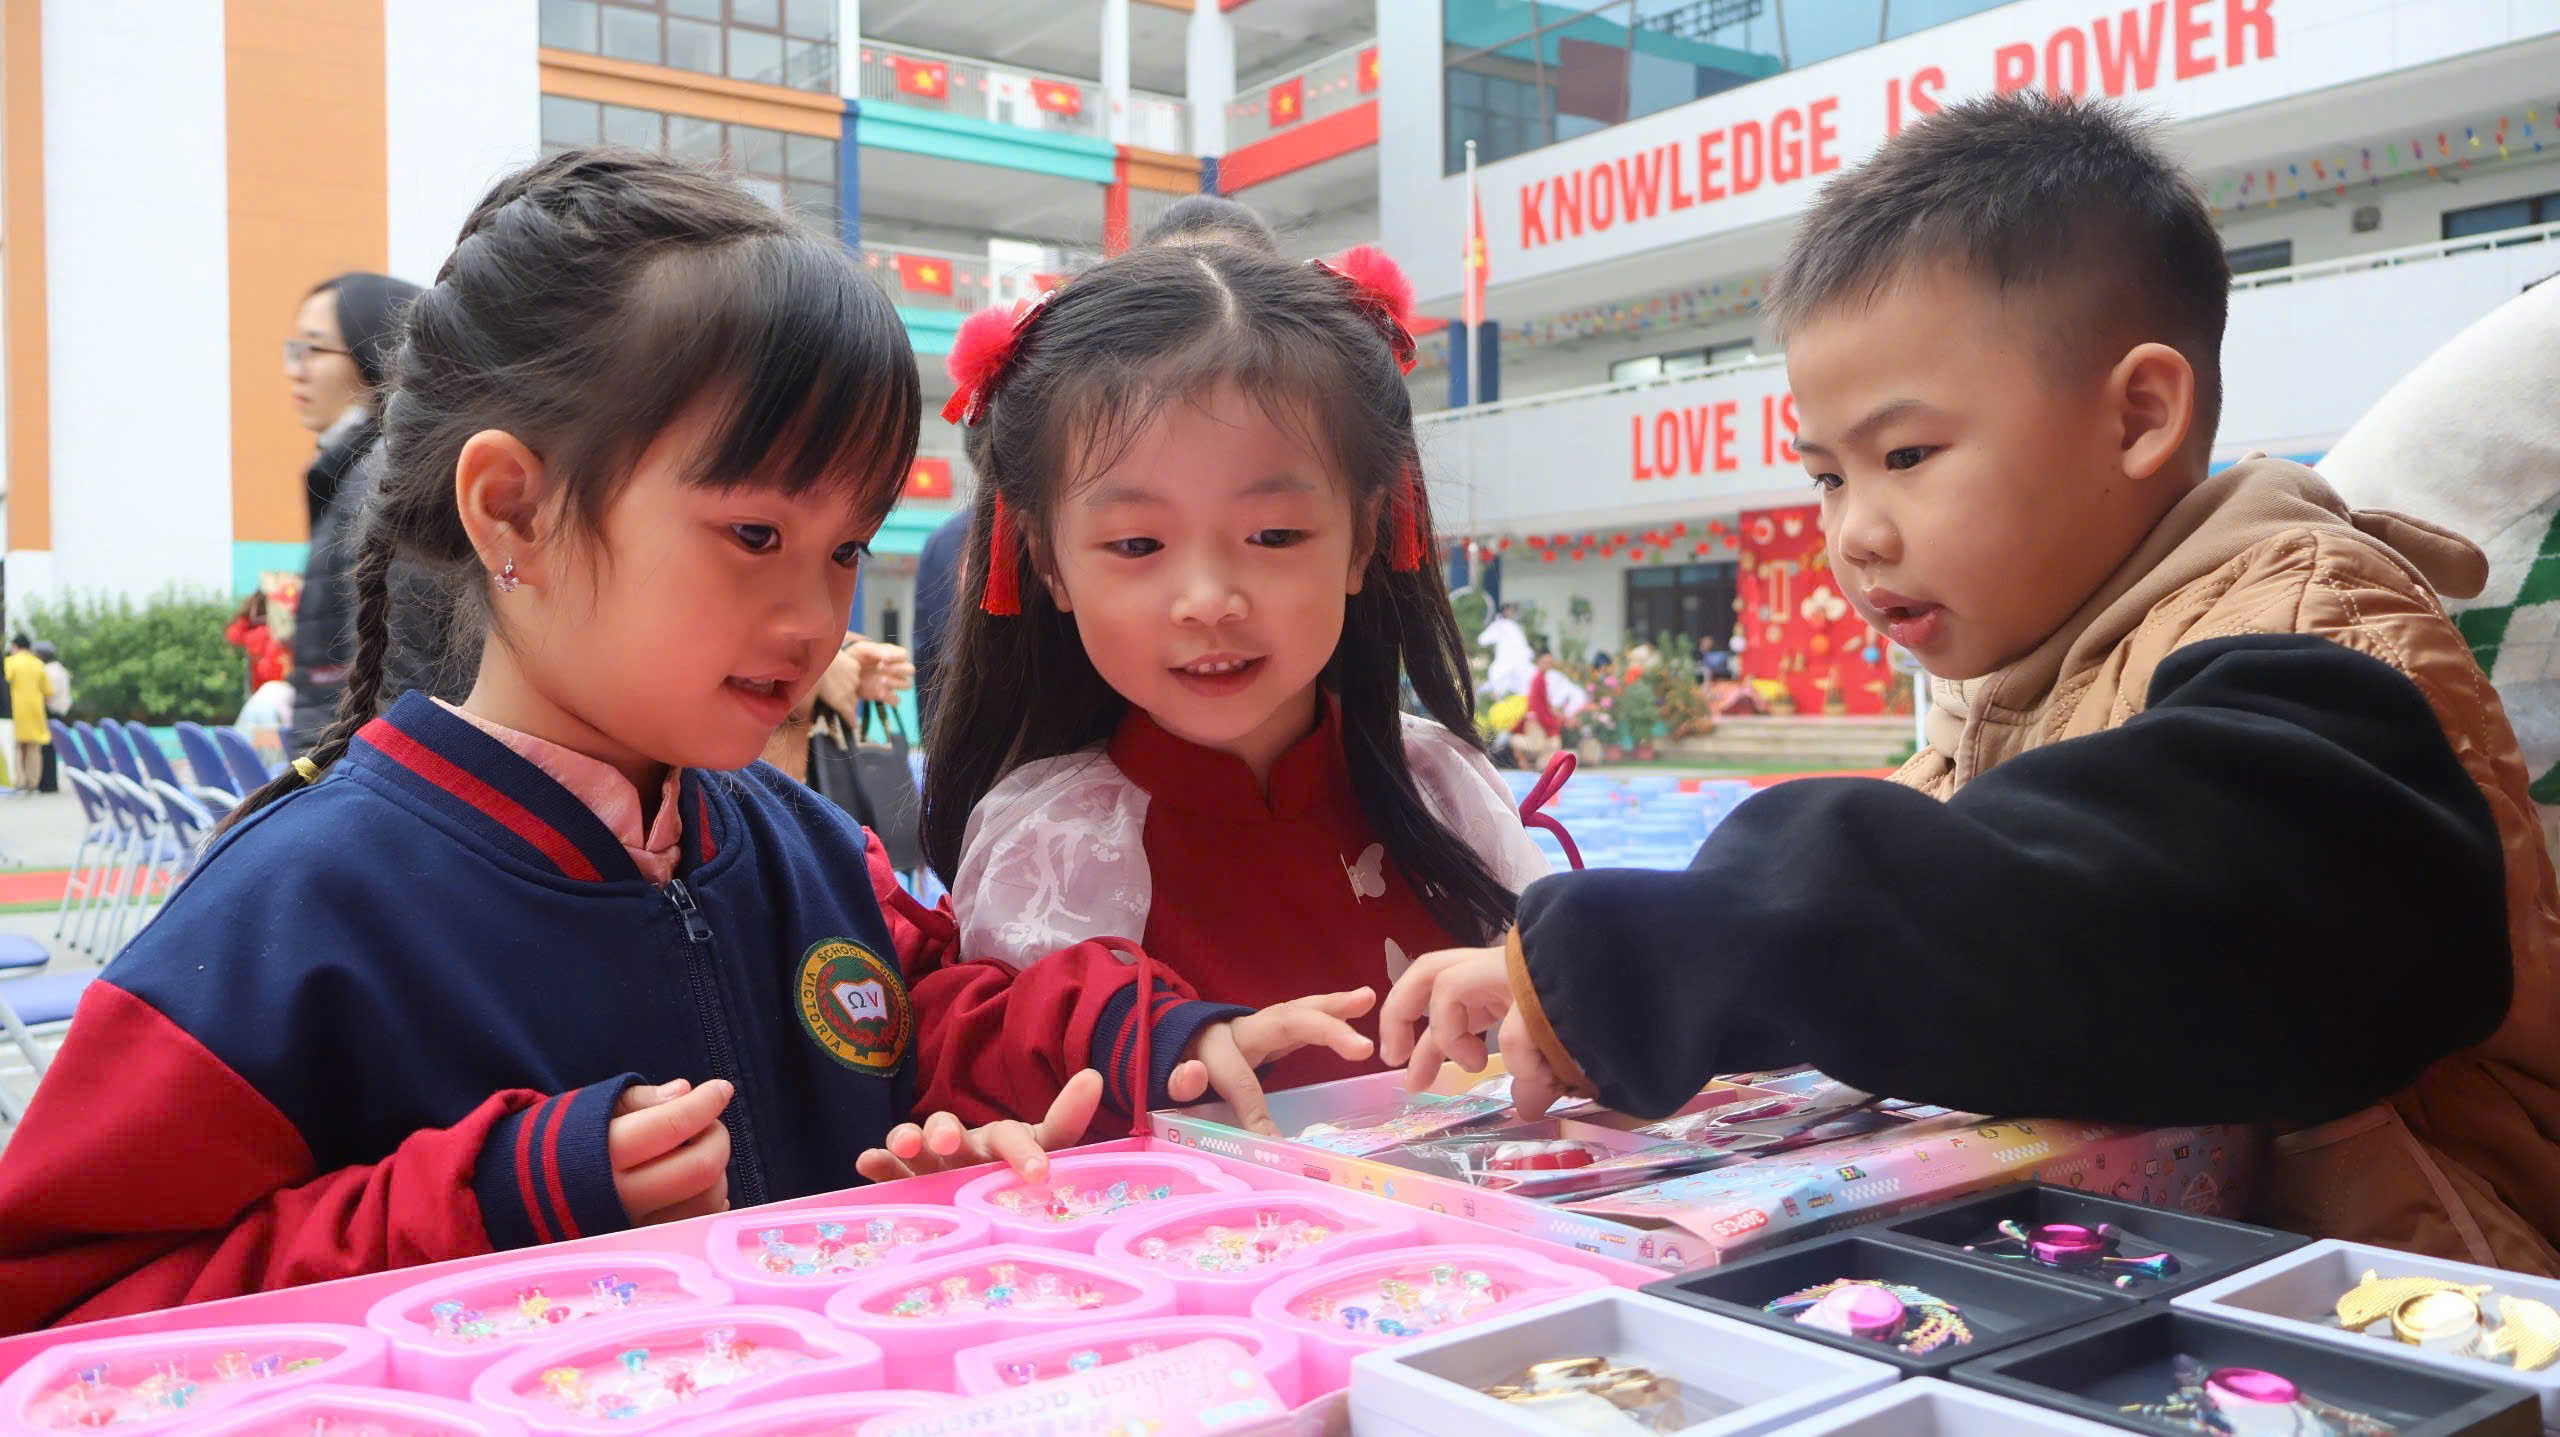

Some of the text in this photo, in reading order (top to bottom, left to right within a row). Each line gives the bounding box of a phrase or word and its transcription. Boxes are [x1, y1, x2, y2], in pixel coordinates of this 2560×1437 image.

[1520, 0, 2277, 249] KNOWLEDGE IS POWER
[1632, 393, 1801, 482] LOVE IS
[816, 945, 866, 963] SCHOOL
[803, 971, 841, 1052] VICTORIA
[1713, 1210, 1765, 1237] 30PCS
